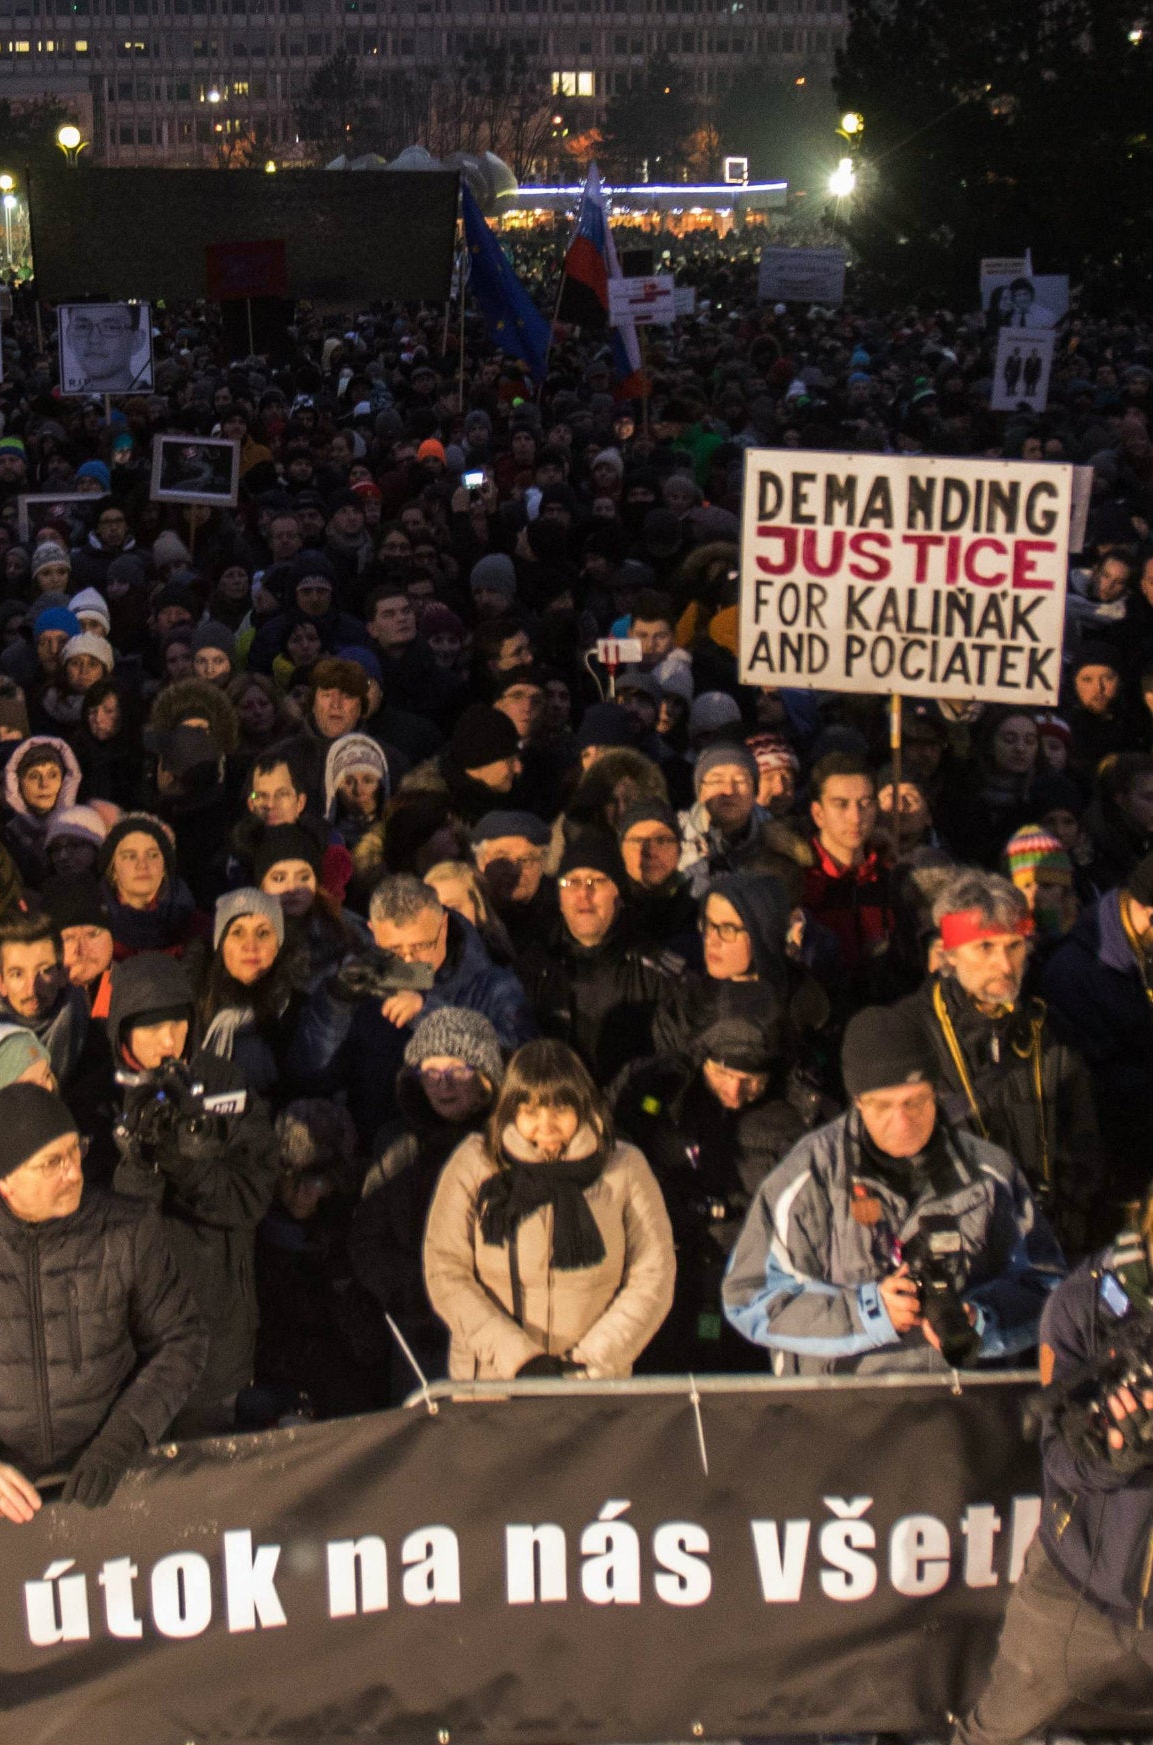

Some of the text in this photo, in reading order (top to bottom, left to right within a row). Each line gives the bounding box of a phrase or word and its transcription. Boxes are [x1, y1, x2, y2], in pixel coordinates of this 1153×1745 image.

[756, 470, 1060, 536] DEMANDING
[755, 526, 1058, 590] JUSTICE
[754, 580, 827, 630] FOR
[748, 631, 829, 675] AND
[24, 1528, 287, 1647] útok
[326, 1523, 461, 1618] na
[505, 1499, 713, 1606] nás
